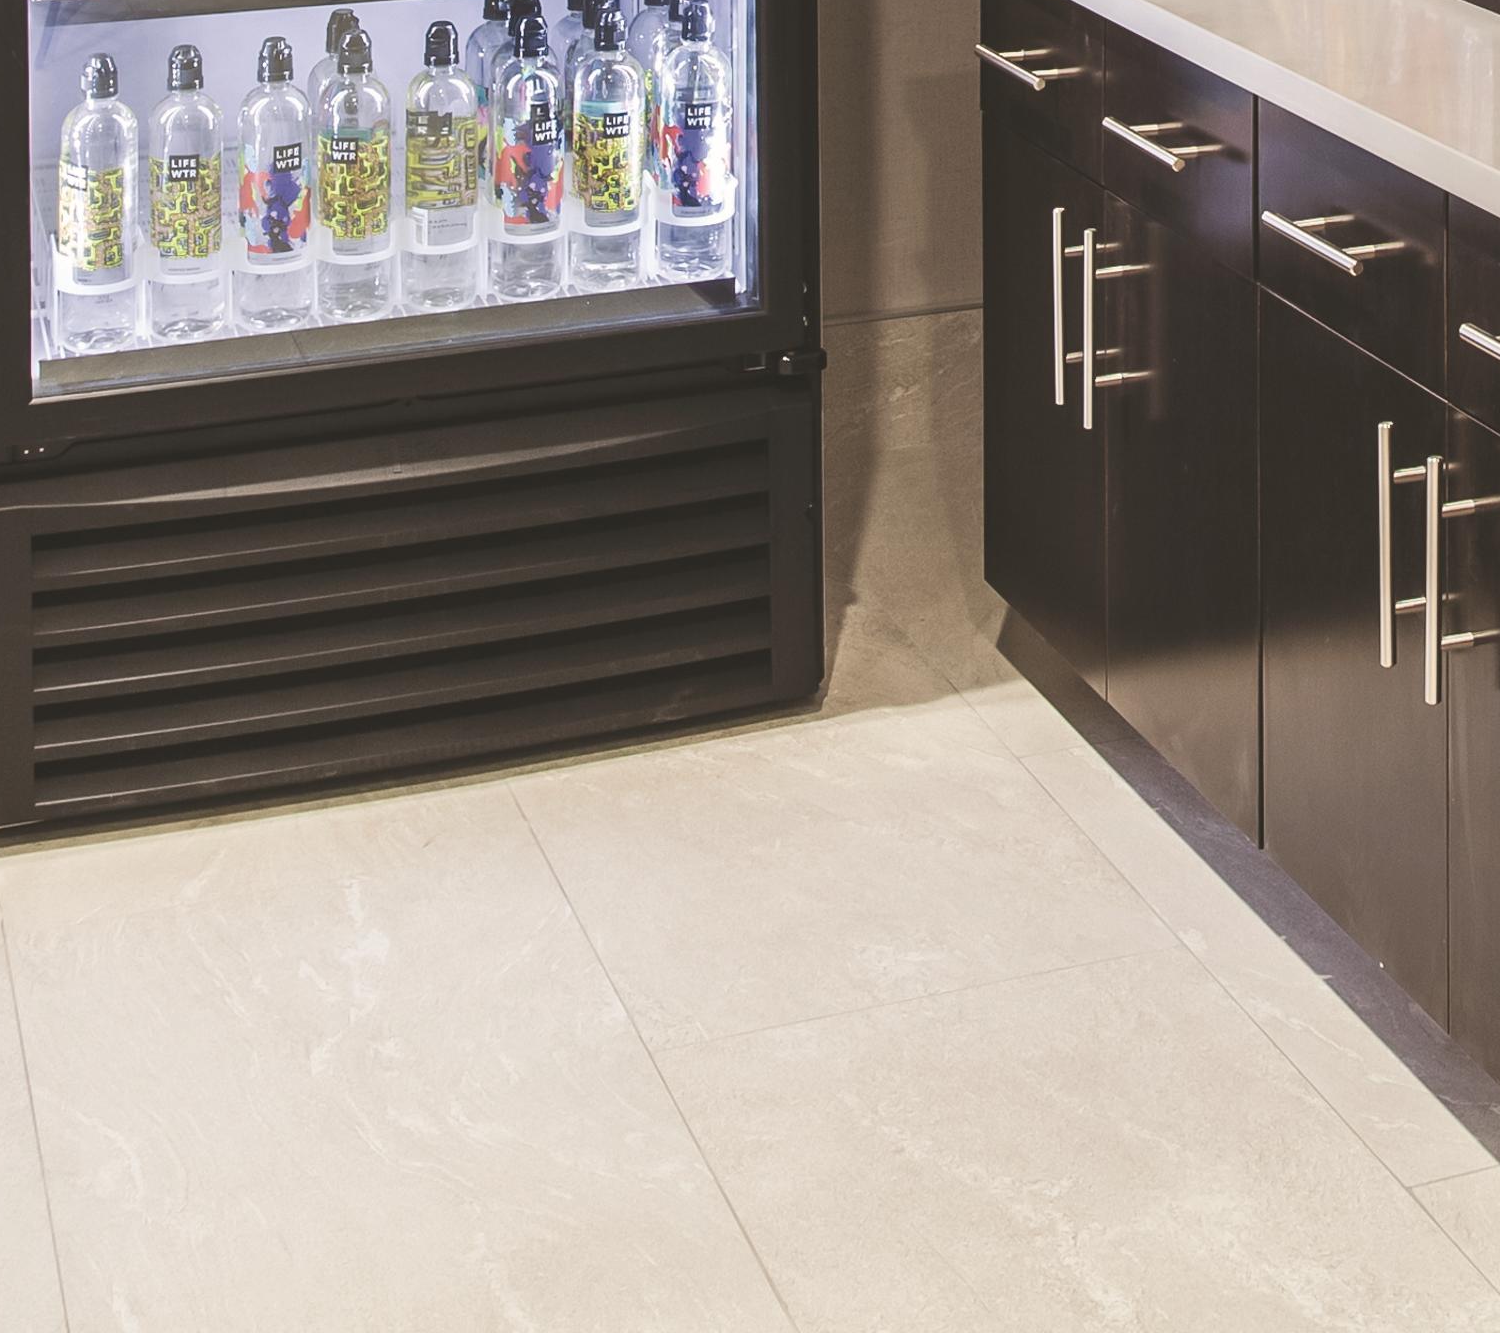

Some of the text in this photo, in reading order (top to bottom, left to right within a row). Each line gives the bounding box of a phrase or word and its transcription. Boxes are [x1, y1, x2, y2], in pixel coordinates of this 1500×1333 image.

[535, 132, 556, 141] WTR
[333, 141, 356, 151] LIFE
[277, 148, 299, 159] LIFE
[332, 151, 356, 160] WTR
[172, 159, 196, 169] LIFE
[171, 169, 196, 178] WTR
